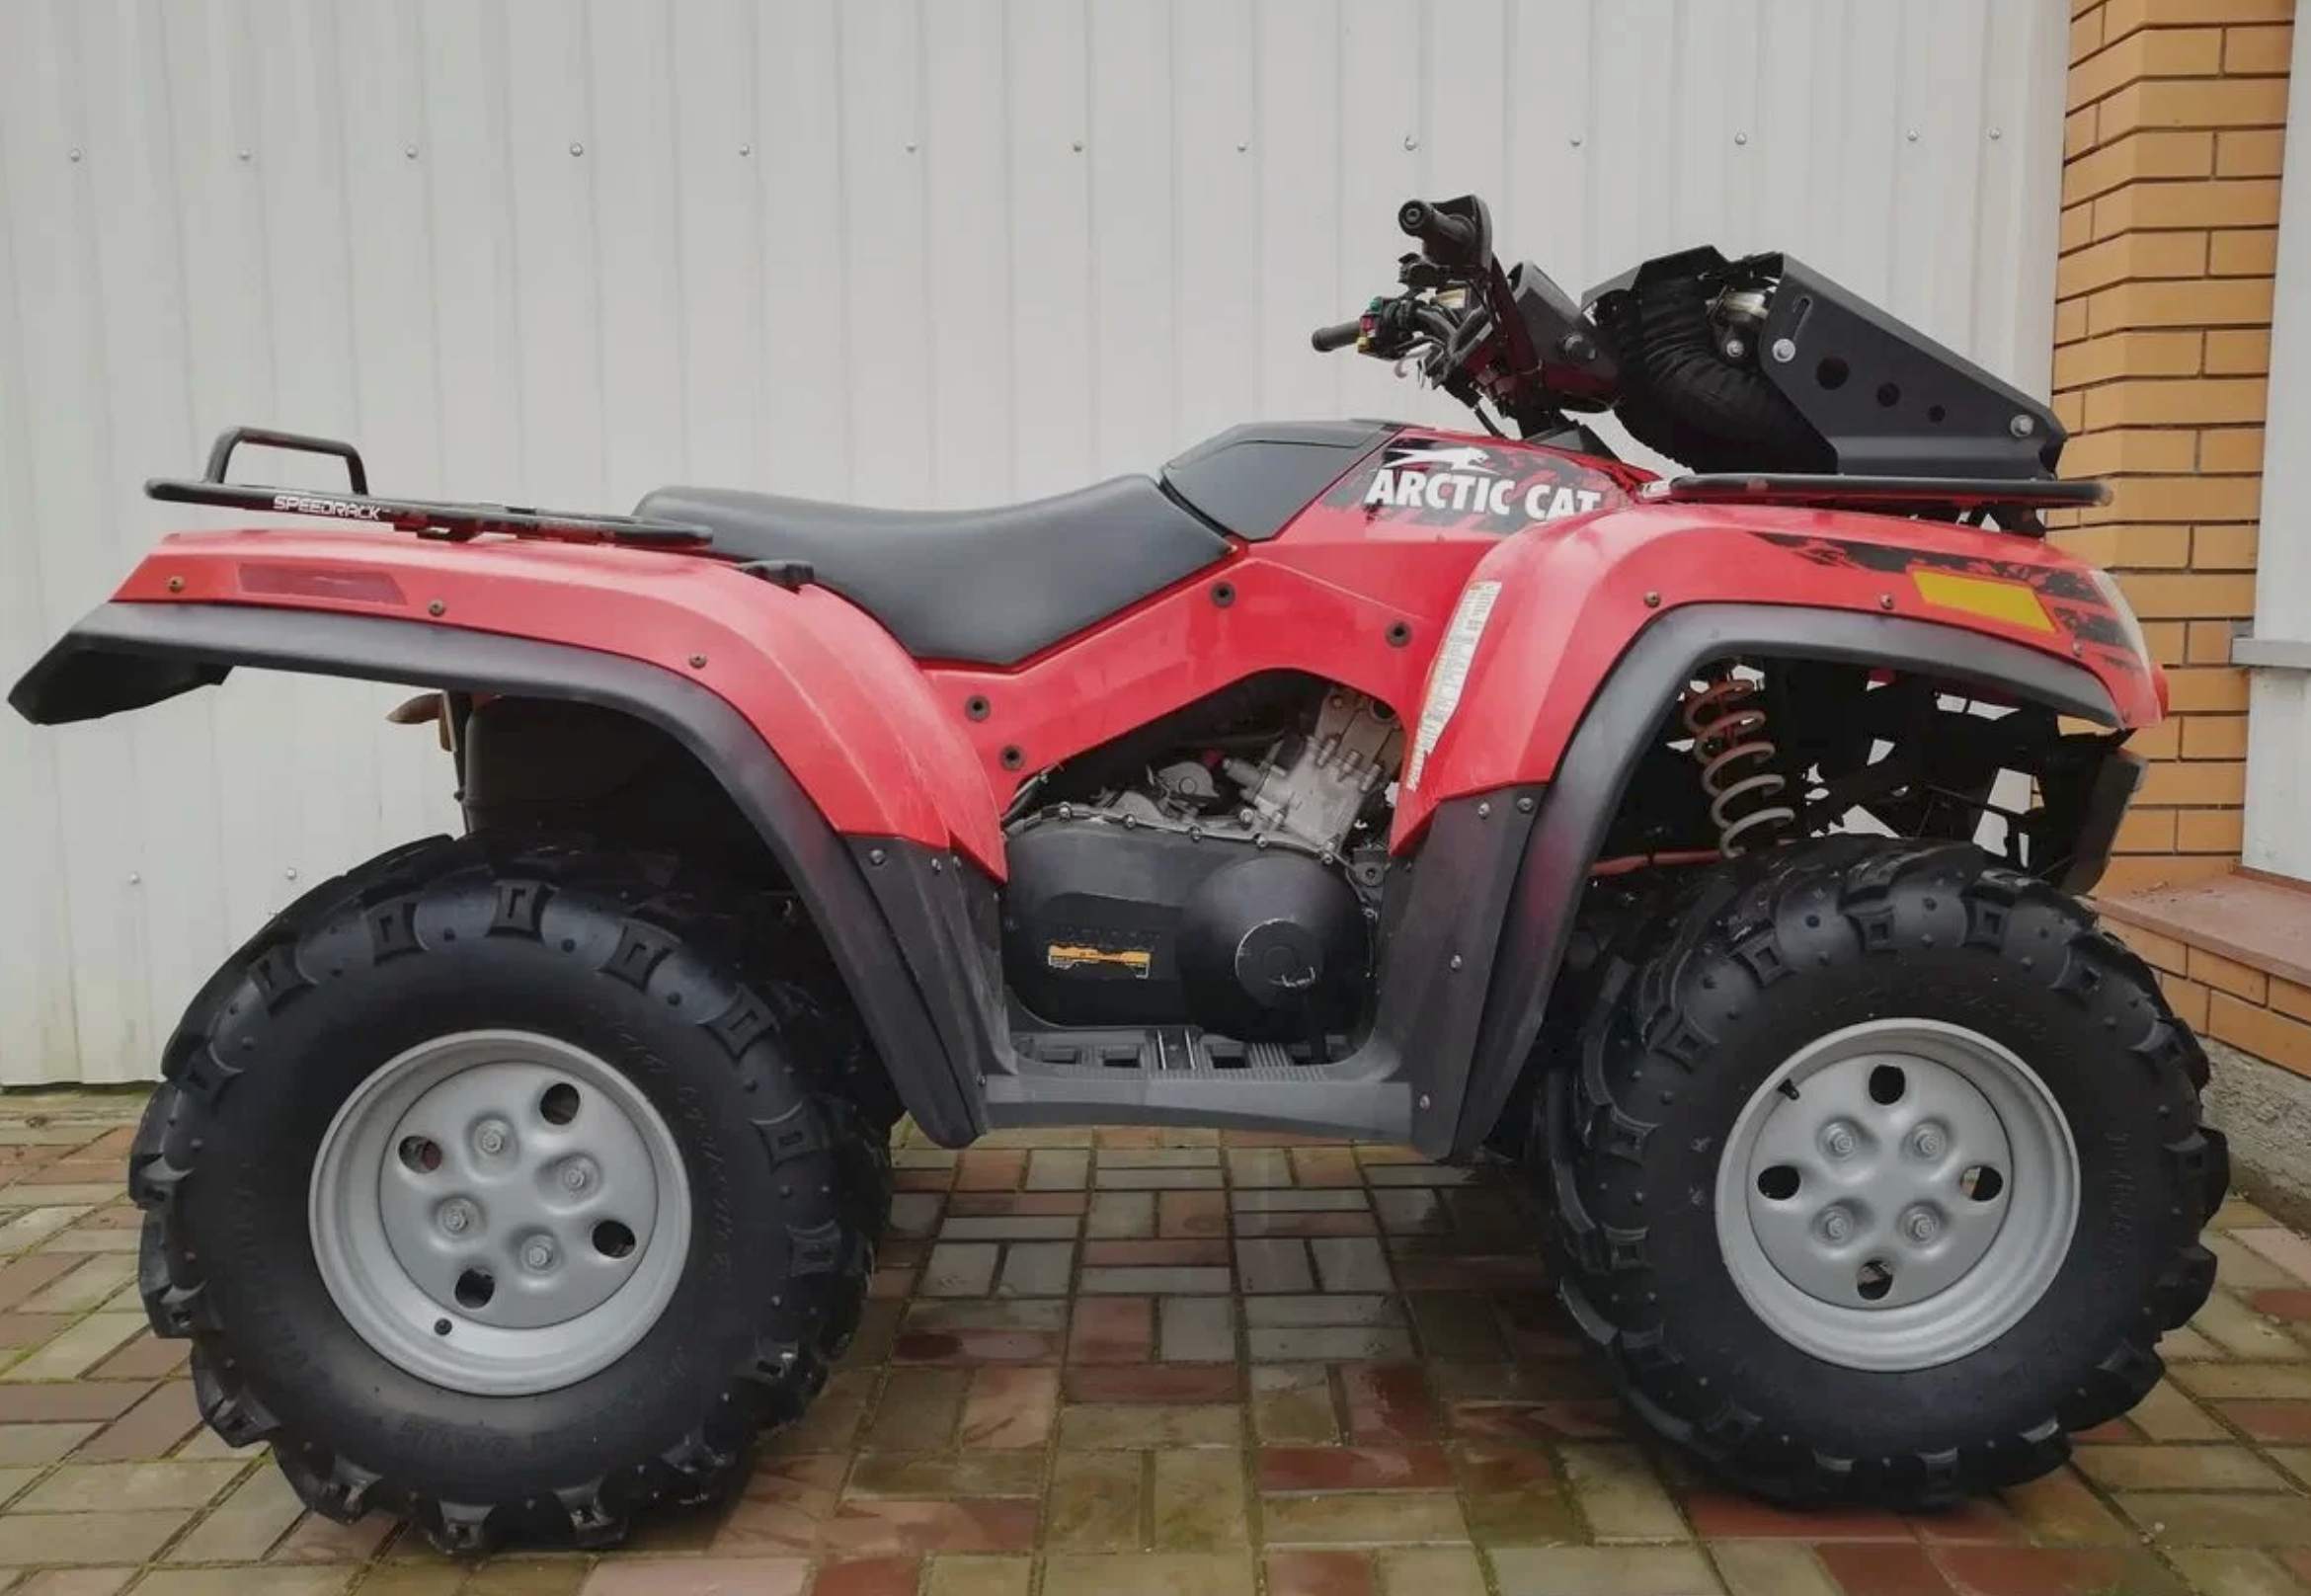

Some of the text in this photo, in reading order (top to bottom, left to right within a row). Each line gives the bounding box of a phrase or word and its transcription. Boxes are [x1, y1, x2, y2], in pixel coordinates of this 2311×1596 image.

[274, 496, 380, 519] SPEEDRACK
[1364, 468, 1601, 520] ARCTIC CAT
